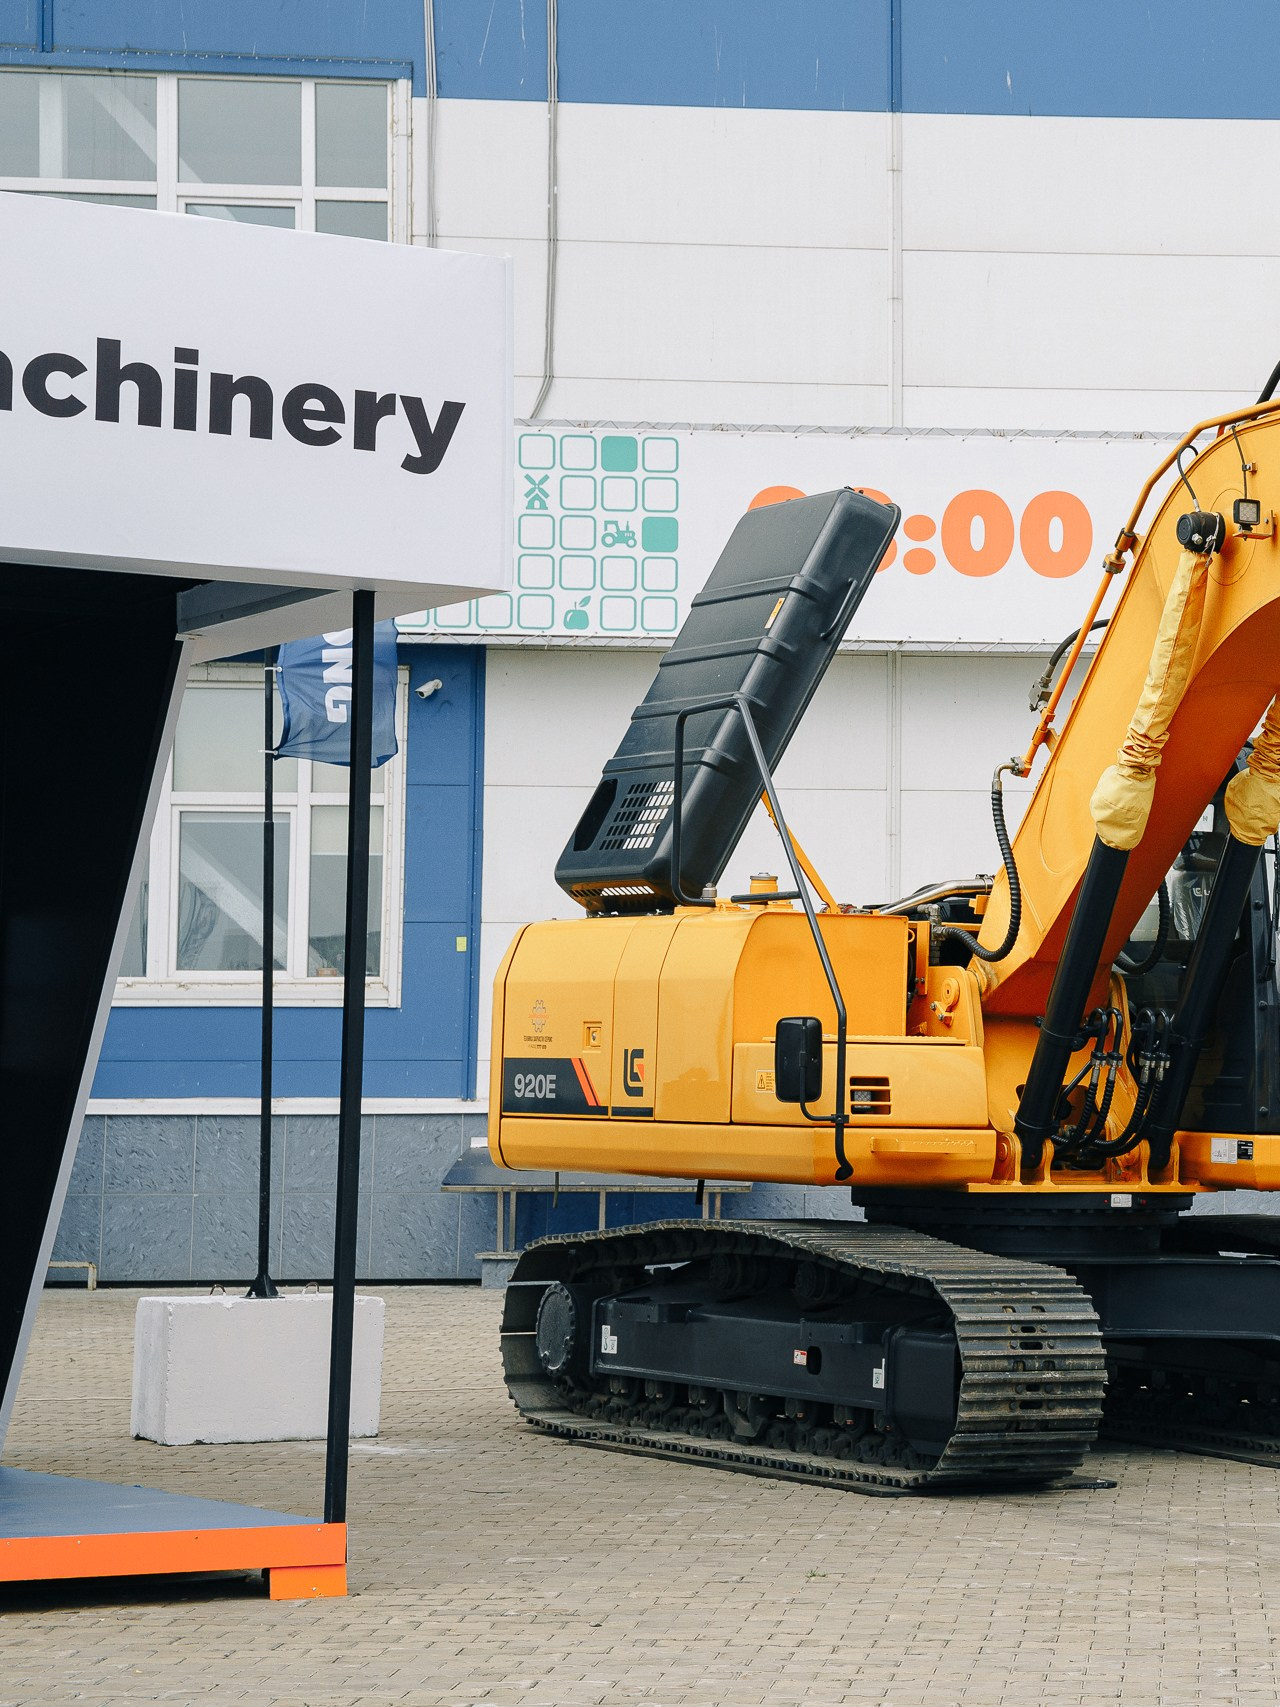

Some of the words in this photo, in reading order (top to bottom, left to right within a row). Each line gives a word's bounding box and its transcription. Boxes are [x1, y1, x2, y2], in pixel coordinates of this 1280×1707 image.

[0, 337, 466, 475] chinery
[747, 485, 1094, 579] :00
[514, 1073, 557, 1099] 920E
